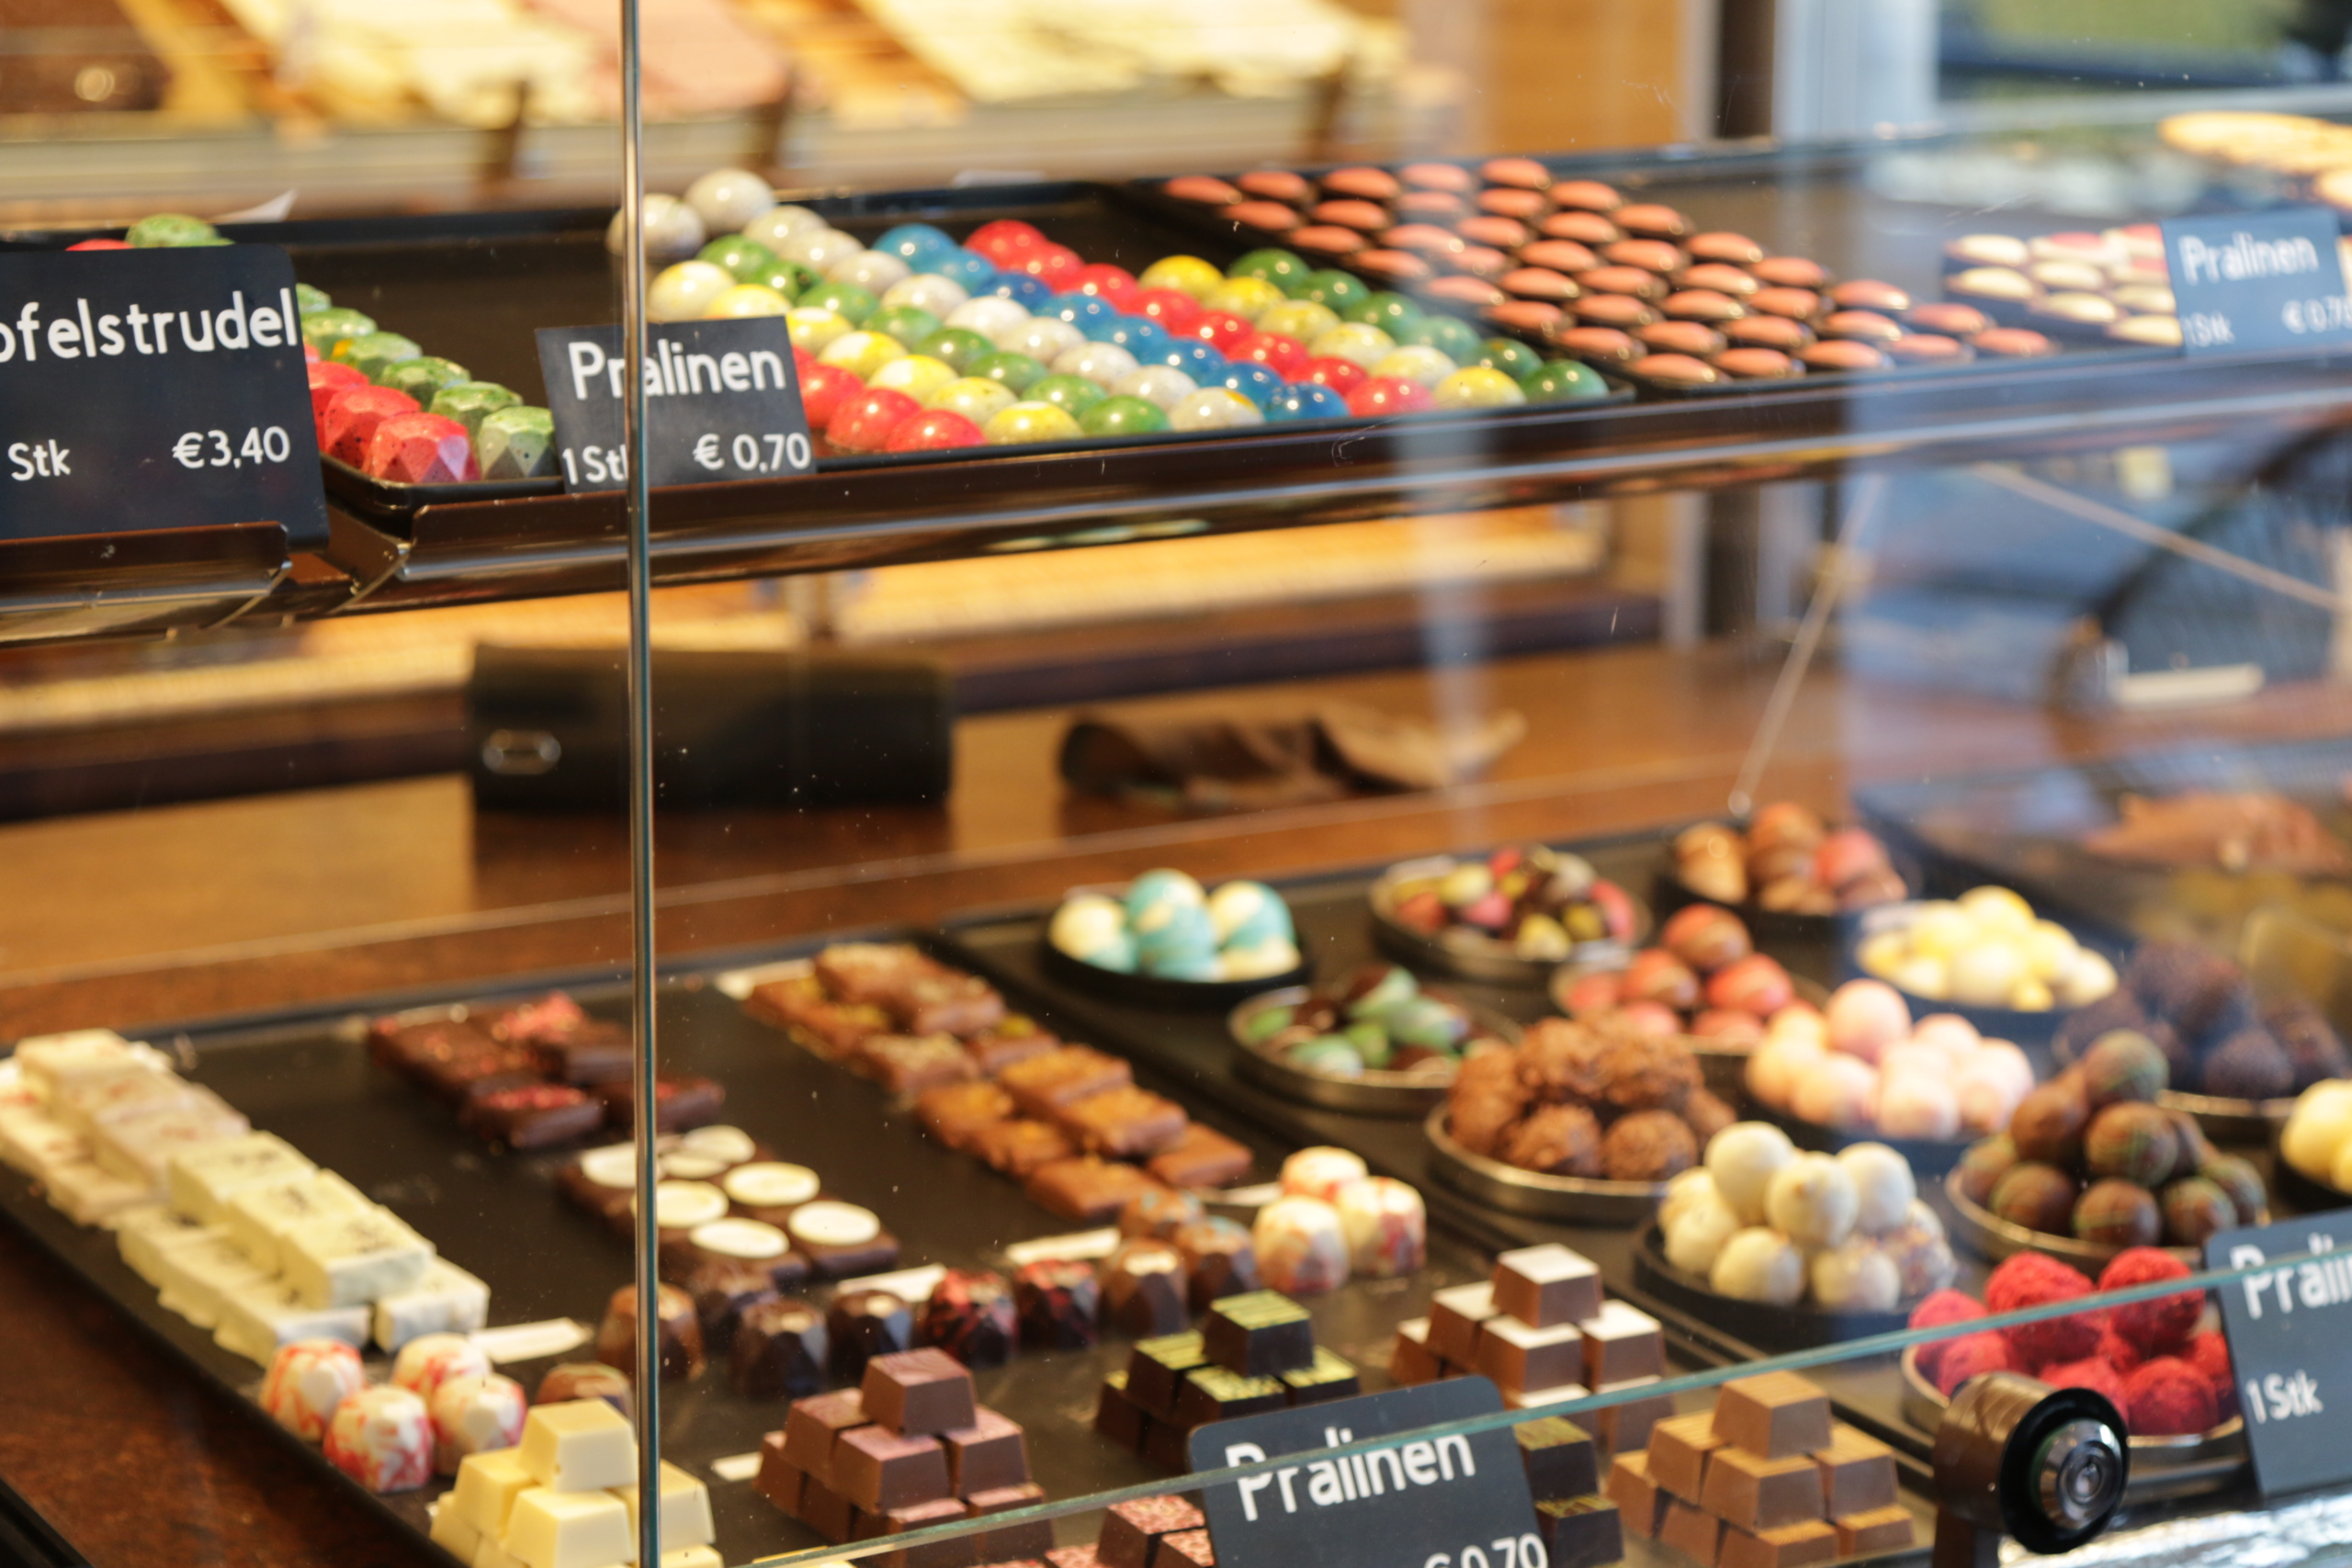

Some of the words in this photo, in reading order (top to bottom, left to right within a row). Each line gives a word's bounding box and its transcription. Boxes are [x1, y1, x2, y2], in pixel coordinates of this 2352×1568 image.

[2177, 231, 2319, 286] Pralinen
[568, 338, 786, 400] Pralinen
[7, 439, 71, 481] Stk
[1225, 1427, 1476, 1522] Pralinen
